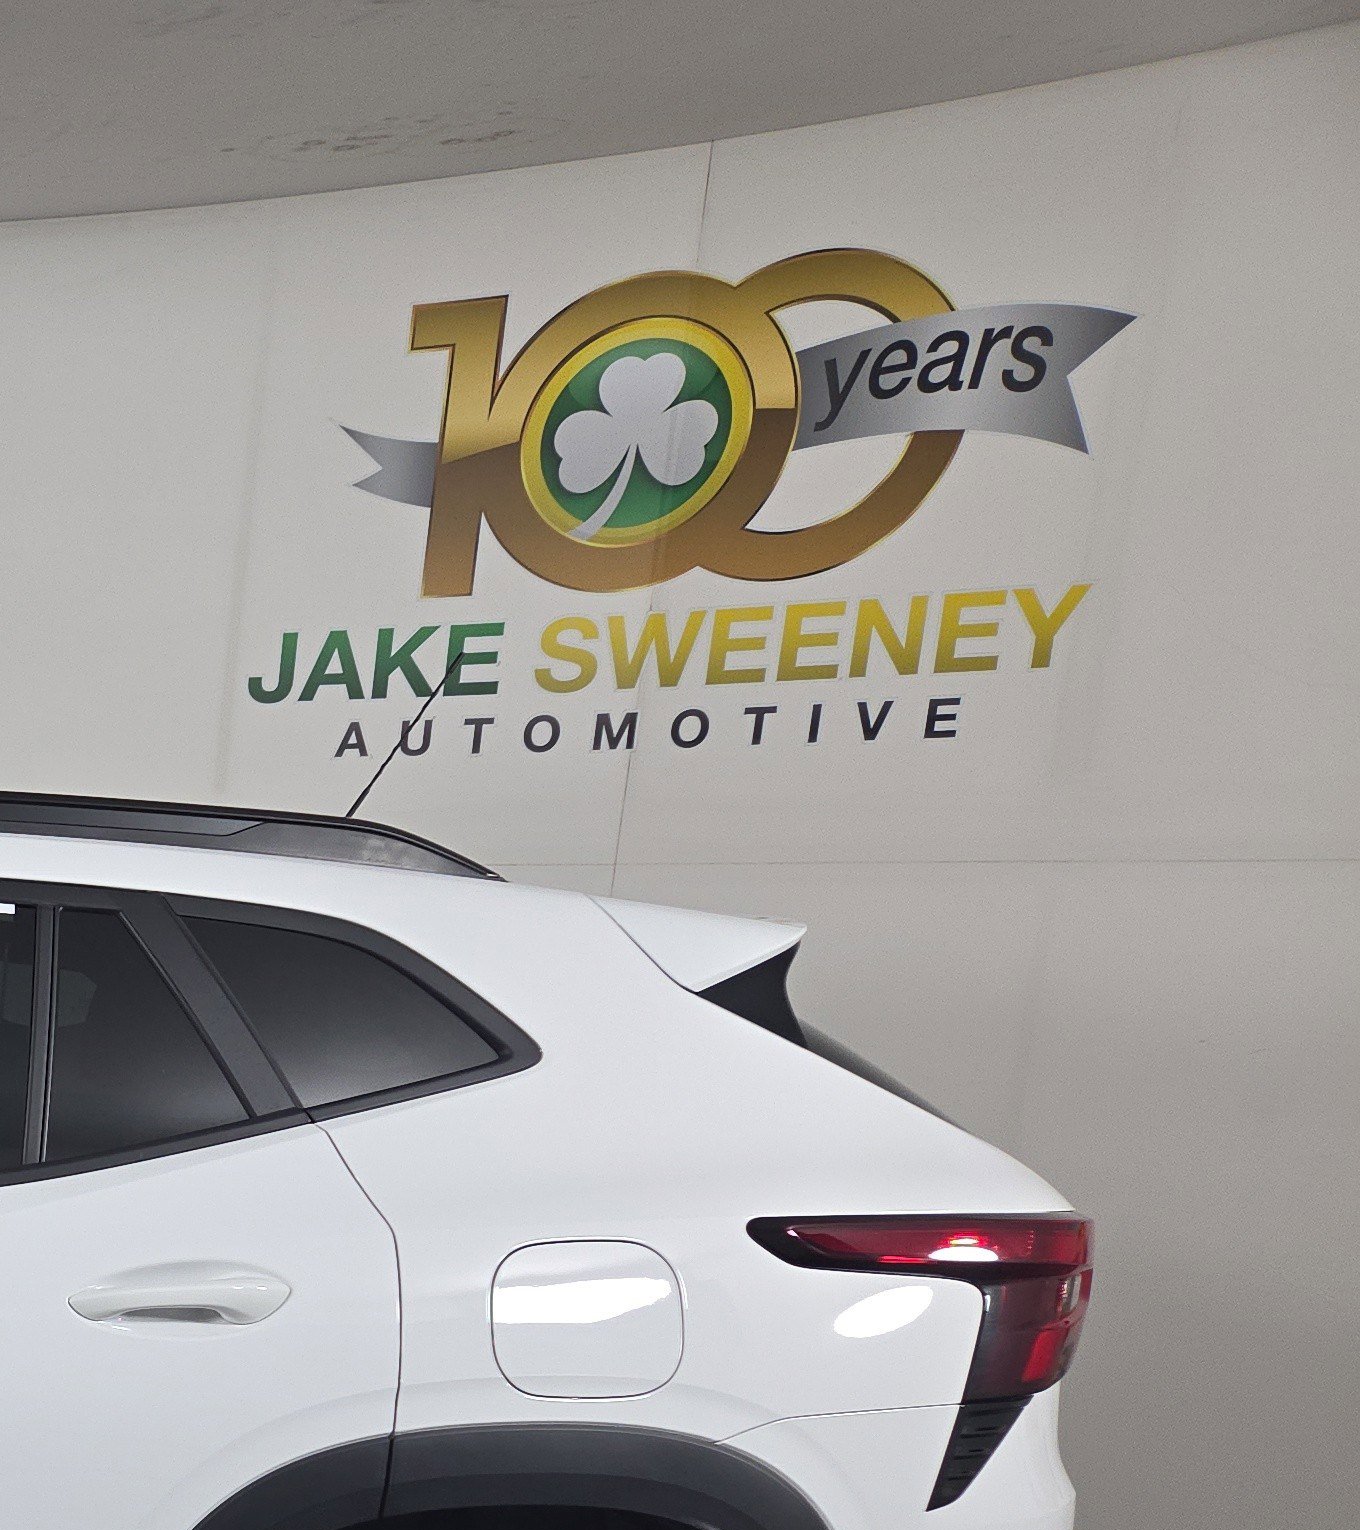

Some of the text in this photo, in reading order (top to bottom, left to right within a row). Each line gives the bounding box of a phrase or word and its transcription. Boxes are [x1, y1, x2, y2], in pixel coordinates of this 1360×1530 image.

[813, 322, 1054, 432] years
[246, 583, 1093, 704] JAKE SWEENEY
[334, 697, 964, 758] AUTOMOTIVE
